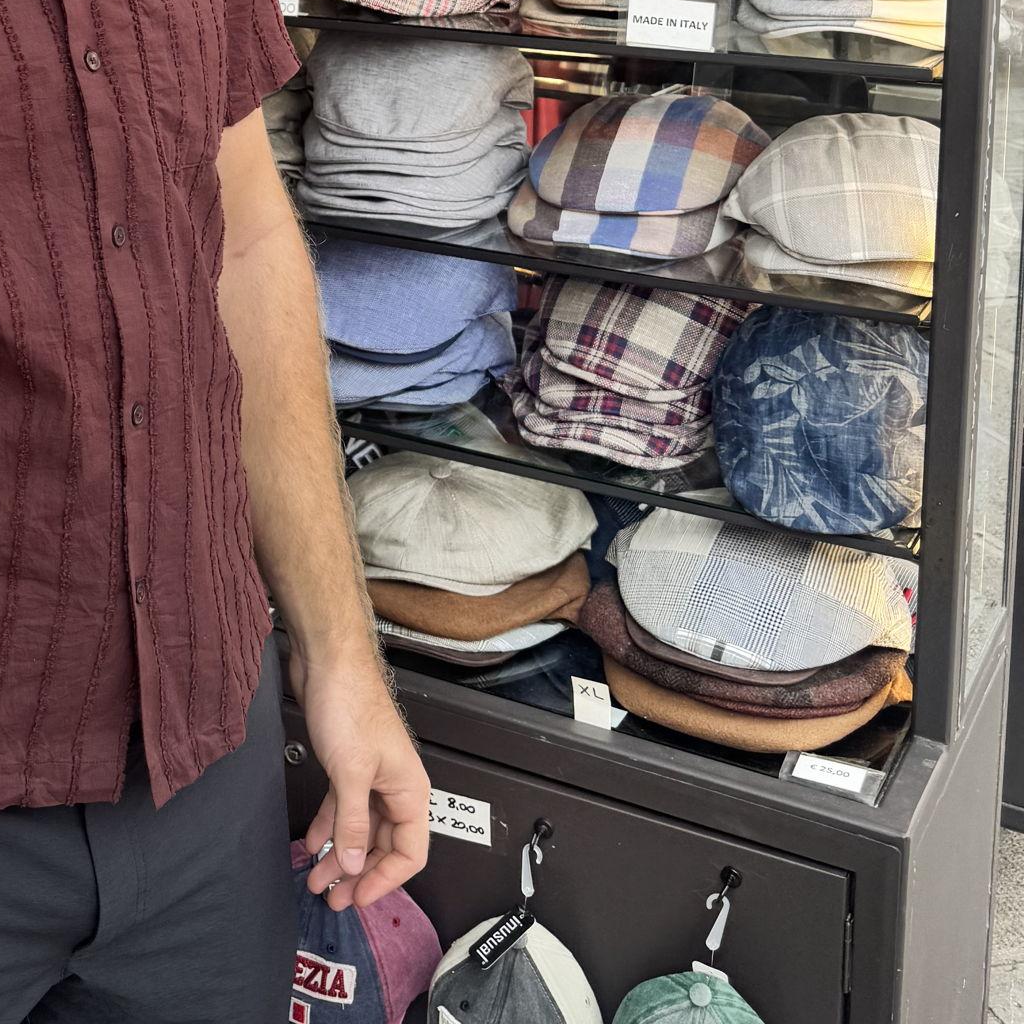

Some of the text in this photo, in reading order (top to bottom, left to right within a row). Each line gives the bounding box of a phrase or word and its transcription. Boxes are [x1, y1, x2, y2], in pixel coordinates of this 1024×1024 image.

[632, 15, 708, 30] MADE IN ITALY
[578, 684, 604, 700] XL
